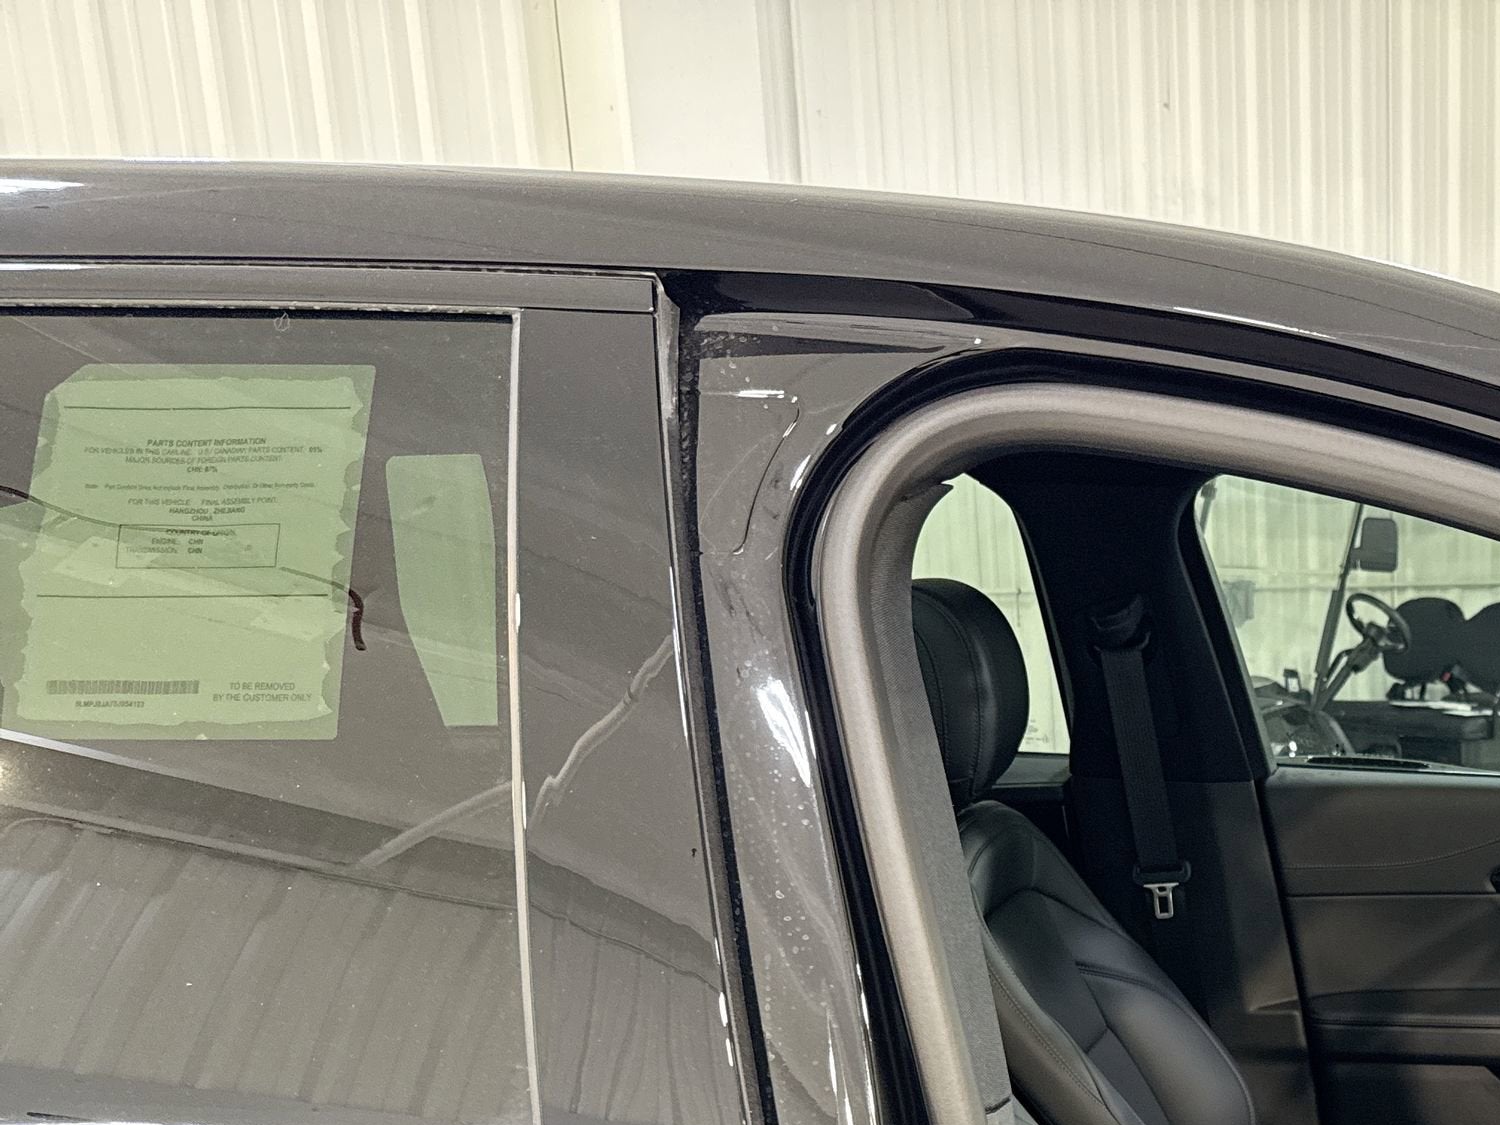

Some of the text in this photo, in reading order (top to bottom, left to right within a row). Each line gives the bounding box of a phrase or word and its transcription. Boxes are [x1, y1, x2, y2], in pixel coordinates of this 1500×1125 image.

[147, 437, 266, 448] PARTS CONTENT INFORMATION
[128, 498, 144, 506] FOR
[201, 498, 220, 506] FINAL
[221, 497, 256, 506] ASSEMBLY
[230, 682, 296, 690] TO BE REMOVED
[212, 693, 312, 702] BY THE CUSTOMER ONLY
